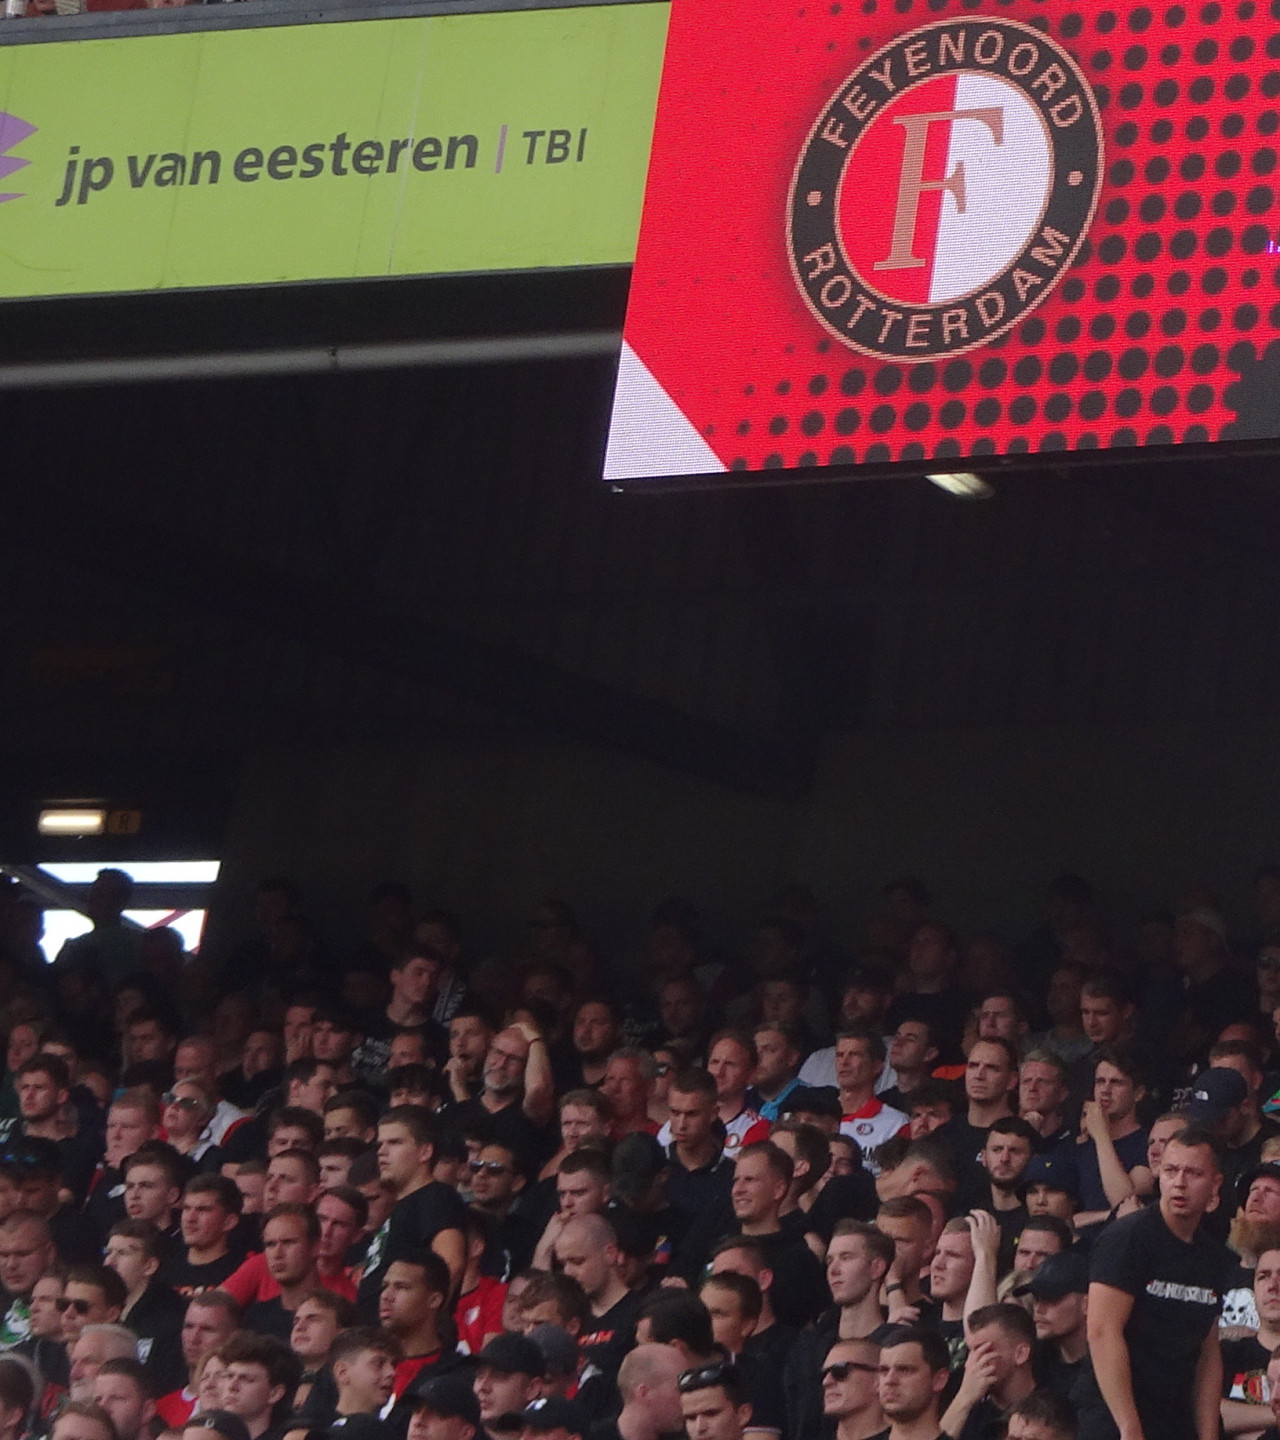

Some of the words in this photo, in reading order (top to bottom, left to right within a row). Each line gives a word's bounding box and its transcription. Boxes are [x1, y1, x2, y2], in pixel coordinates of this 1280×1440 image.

[821, 29, 1084, 148] FEYENOORD
[55, 145, 114, 206] jp
[126, 150, 223, 187] van
[233, 132, 480, 183] eesteren
[521, 127, 588, 165] TBI
[803, 226, 1071, 348] ROTTERDAM
